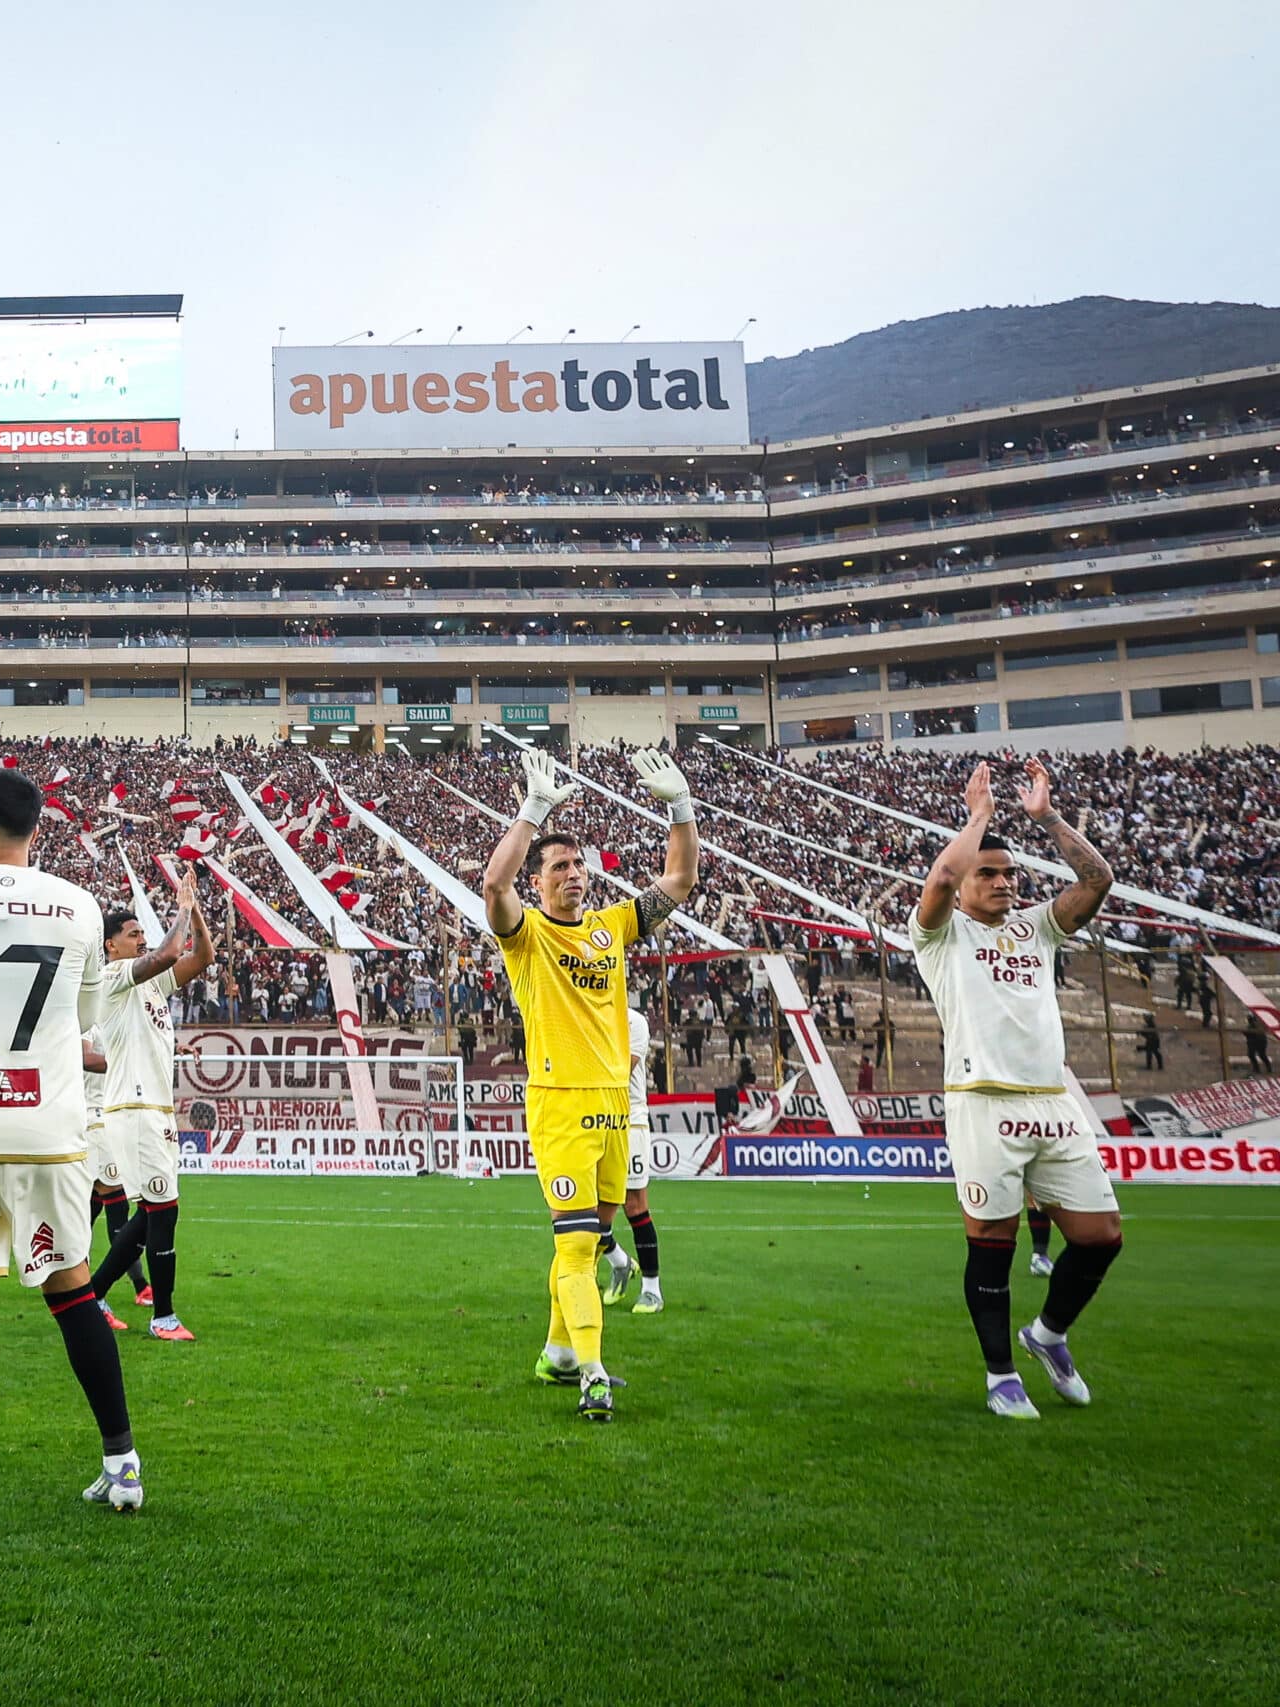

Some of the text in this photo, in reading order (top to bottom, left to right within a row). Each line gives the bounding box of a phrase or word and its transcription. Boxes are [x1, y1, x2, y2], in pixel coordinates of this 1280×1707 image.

[288, 356, 730, 429] apuestatotal
[313, 709, 351, 720] SALIDA
[409, 709, 447, 720] SALIDA
[506, 708, 545, 719] SALIDA
[704, 708, 735, 718] SALIDA
[572, 972, 609, 990] total
[217, 1099, 239, 1115] EN
[244, 1099, 266, 1116] LA
[212, 1156, 306, 1171] apuestatotal
[316, 1155, 412, 1172] apuestatotal
[24, 1252, 65, 1274] ALTOS
